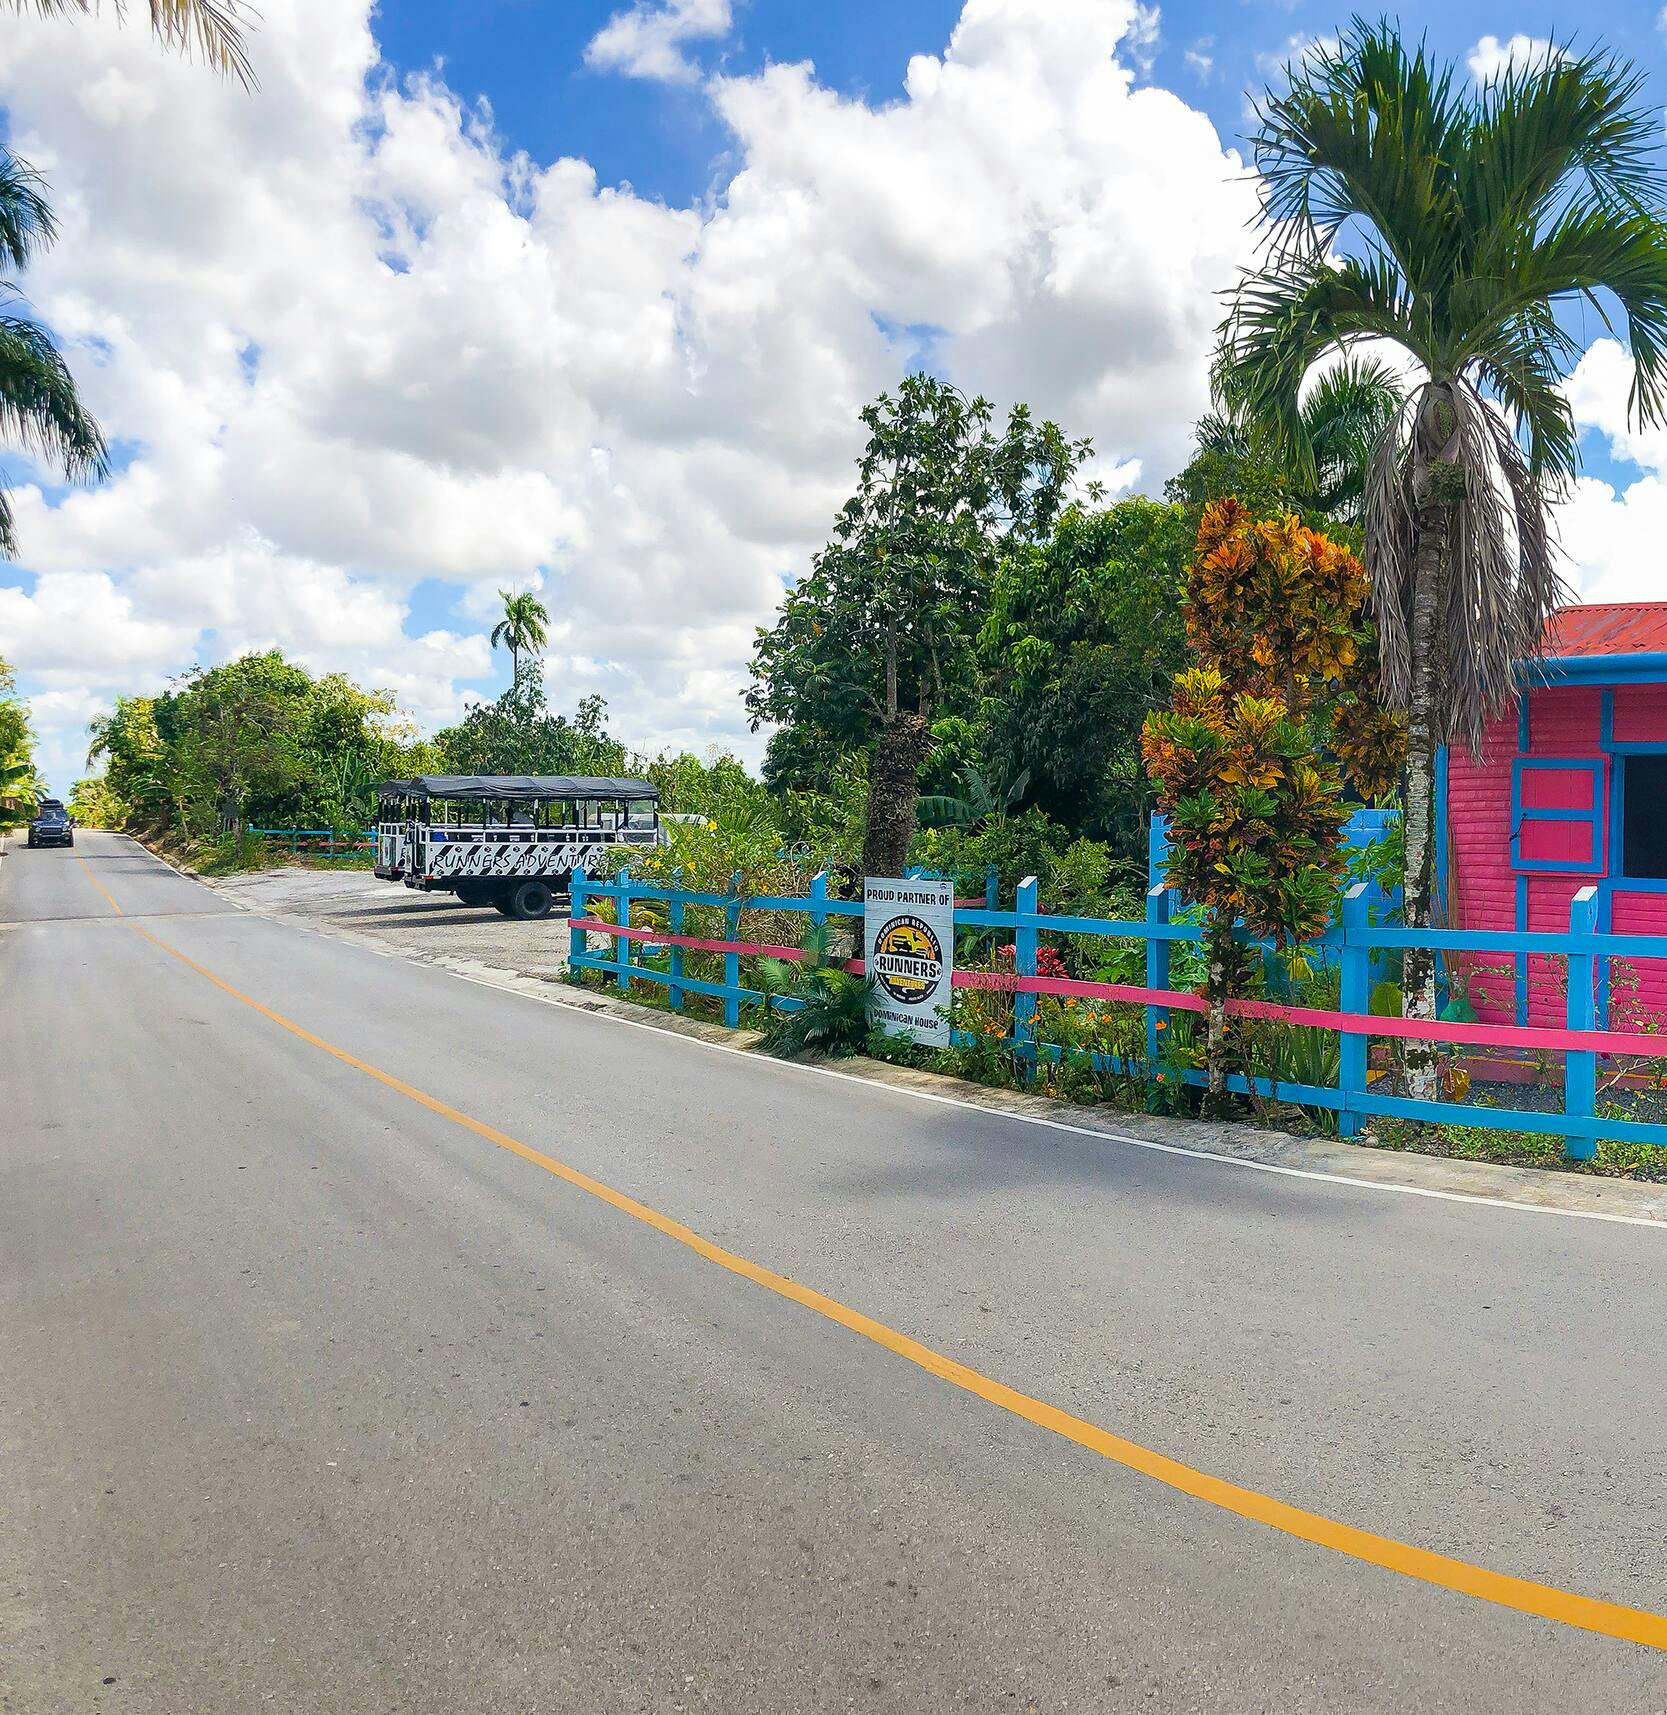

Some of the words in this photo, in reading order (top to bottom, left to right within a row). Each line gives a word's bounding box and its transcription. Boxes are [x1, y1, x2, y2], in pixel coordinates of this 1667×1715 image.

[433, 854, 512, 869] RUNNERS
[515, 853, 608, 869] ADVENTUR
[867, 889, 894, 901] PROUD
[897, 891, 936, 905] PARTNER
[939, 894, 950, 906] OF
[877, 917, 910, 945] DOMINICAN
[880, 955, 937, 978] RUNNERS
